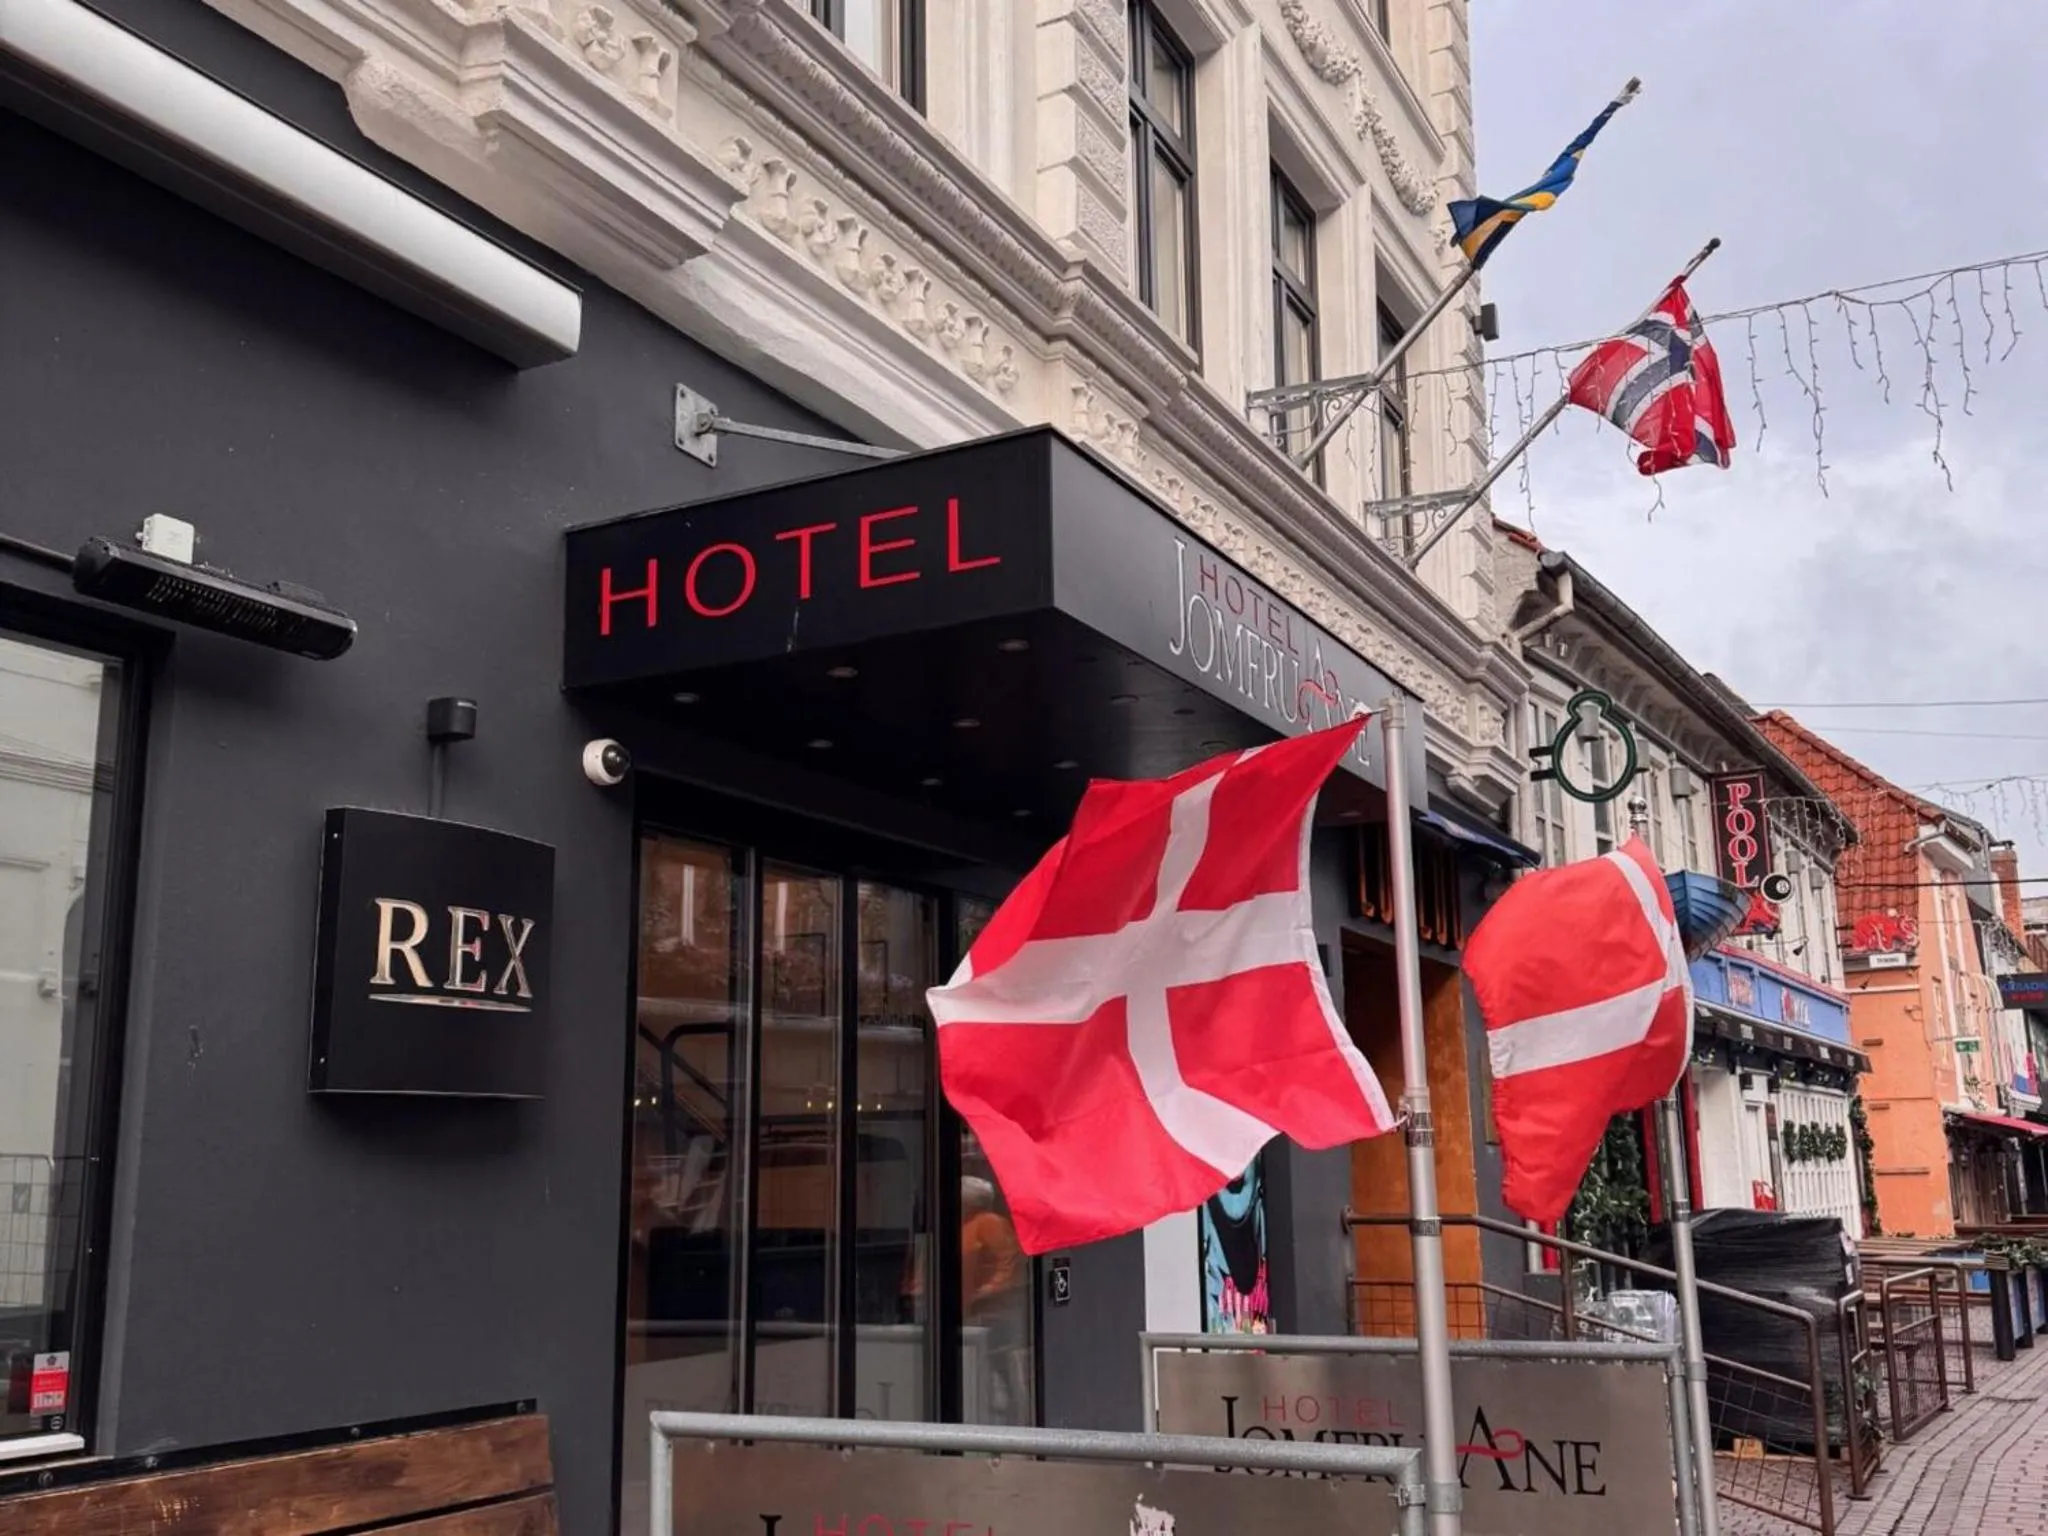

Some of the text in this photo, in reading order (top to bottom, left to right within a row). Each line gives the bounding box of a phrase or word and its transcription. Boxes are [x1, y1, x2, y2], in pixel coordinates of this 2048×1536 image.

[599, 497, 1001, 636] HOTEL
[1199, 553, 1299, 656] HOTEL
[1168, 536, 1300, 724] JOMFRU
[1726, 782, 1760, 888] POOL
[369, 897, 535, 998] REX
[1262, 1395, 1405, 1427] HOTEL
